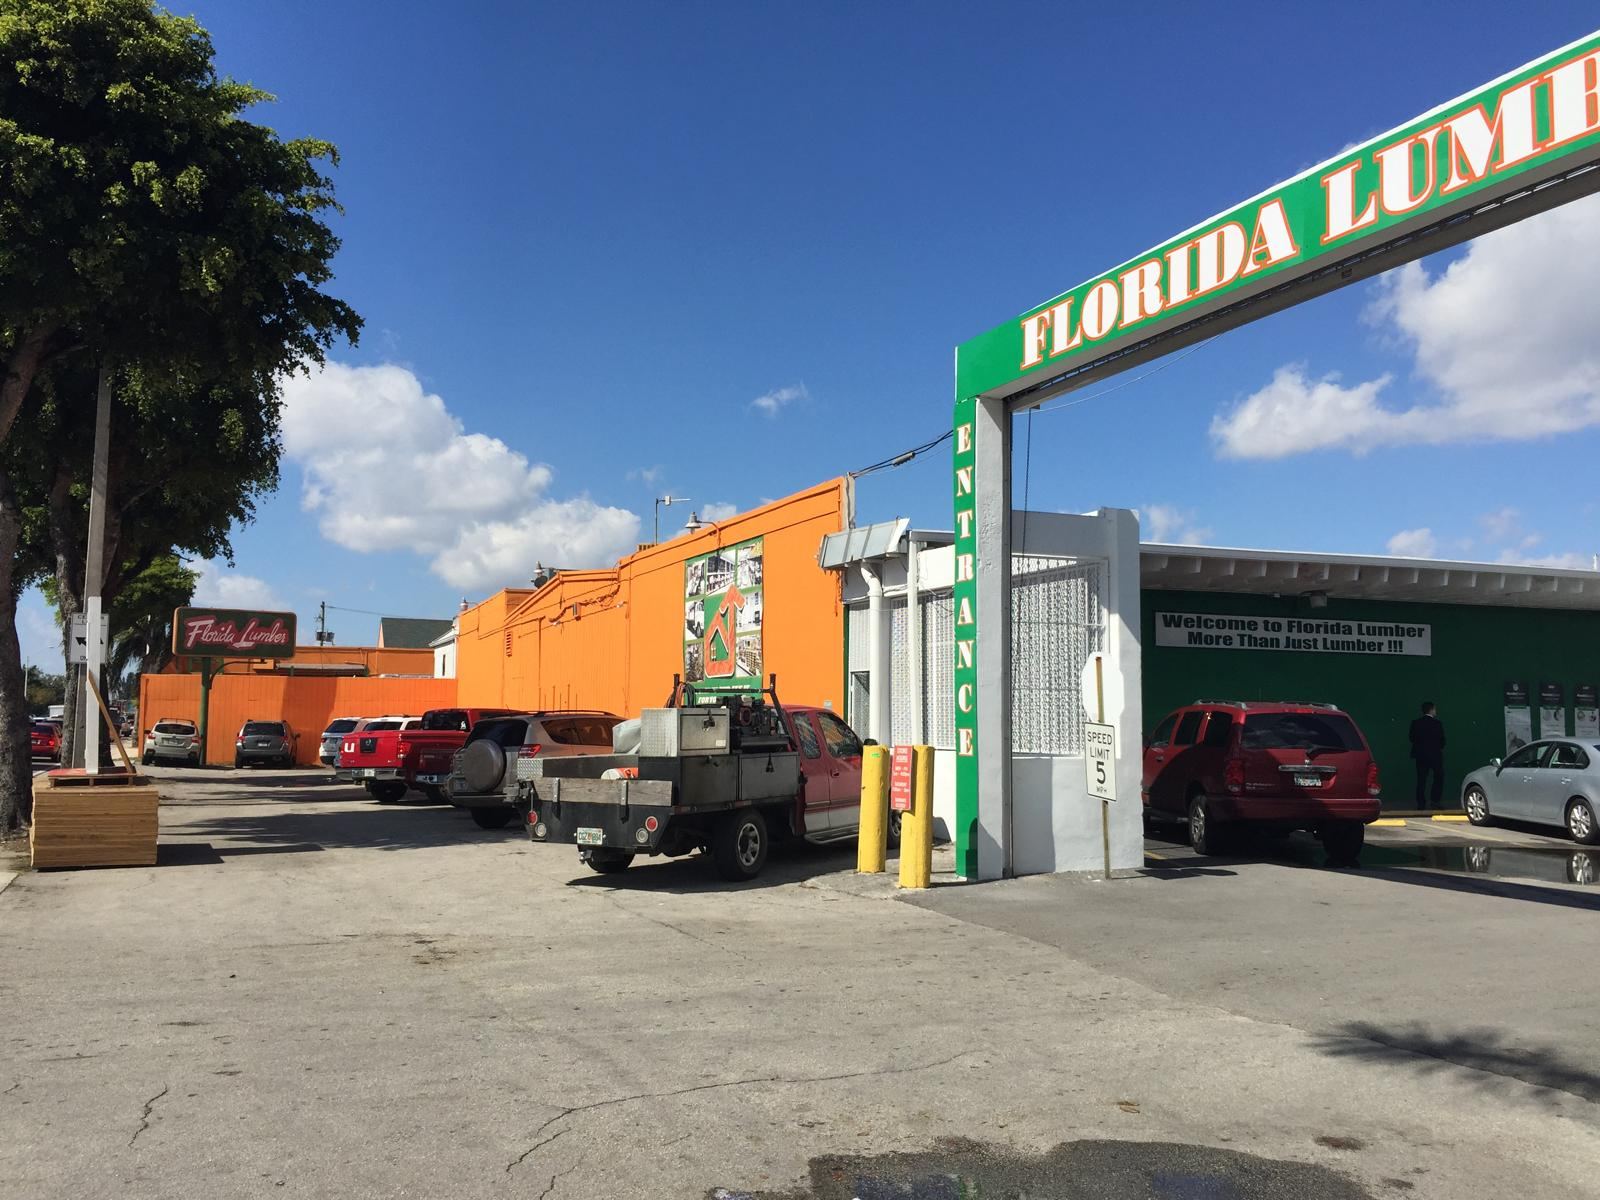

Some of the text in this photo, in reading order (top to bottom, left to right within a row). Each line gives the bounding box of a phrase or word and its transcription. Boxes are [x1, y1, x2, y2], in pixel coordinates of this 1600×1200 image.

[1019, 197, 1300, 372] FLORIDA
[956, 422, 975, 758] ENTRANCE
[186, 619, 286, 649] Florida Lumber
[1162, 613, 1425, 638] Welcome to Florida Lumber
[1187, 631, 1233, 647] More
[1237, 633, 1280, 649] Than
[1284, 634, 1319, 650] Just
[1322, 637, 1384, 653] Lumber
[1087, 731, 1113, 745] SPEED
[1090, 746, 1110, 760] LIMIT
[1096, 760, 1106, 784] 5
